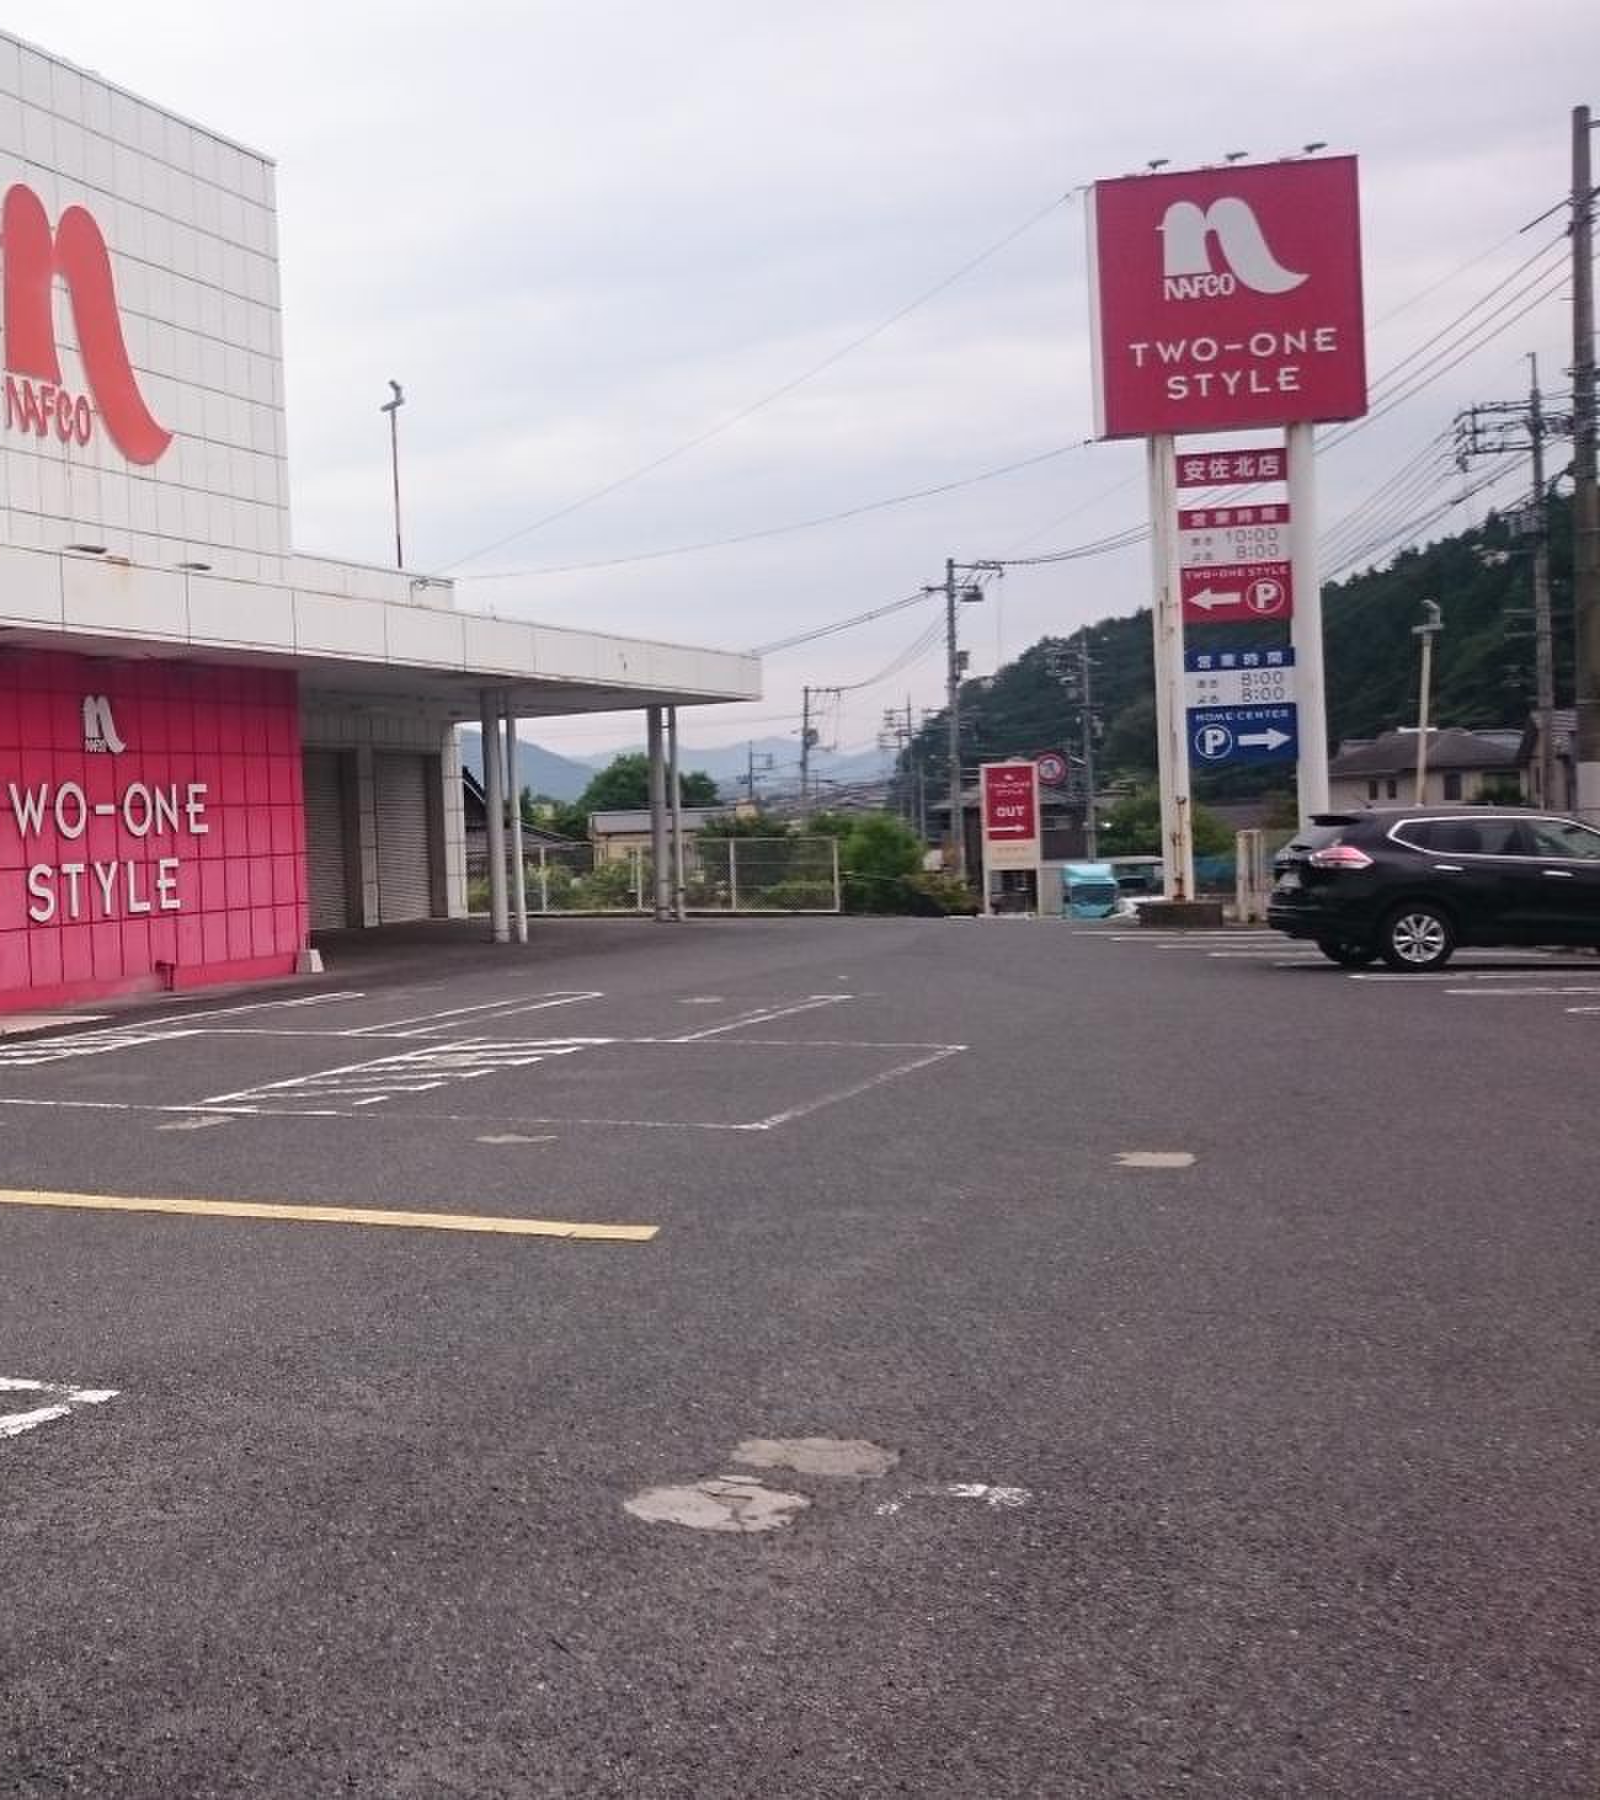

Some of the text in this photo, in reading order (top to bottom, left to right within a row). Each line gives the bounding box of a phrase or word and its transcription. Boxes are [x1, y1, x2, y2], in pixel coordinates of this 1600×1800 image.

[1163, 273, 1236, 301] NAFCO
[1129, 327, 1338, 368] TWO-ONE
[1167, 367, 1301, 400] STYLE
[4, 376, 92, 447] NAFCO
[1184, 455, 1280, 481] 安佐北店
[1226, 528, 1279, 543] 10:00
[1236, 544, 1279, 559] 8:00
[1248, 565, 1287, 577] STYLE
[1256, 583, 1278, 608] P
[1241, 671, 1283, 686] 8:00
[1242, 687, 1285, 702] 8:00
[1196, 708, 1289, 721] HOME CENTER
[1204, 728, 1226, 754] P
[996, 805, 1025, 817] OUT
[27, 858, 181, 922] STYLE
